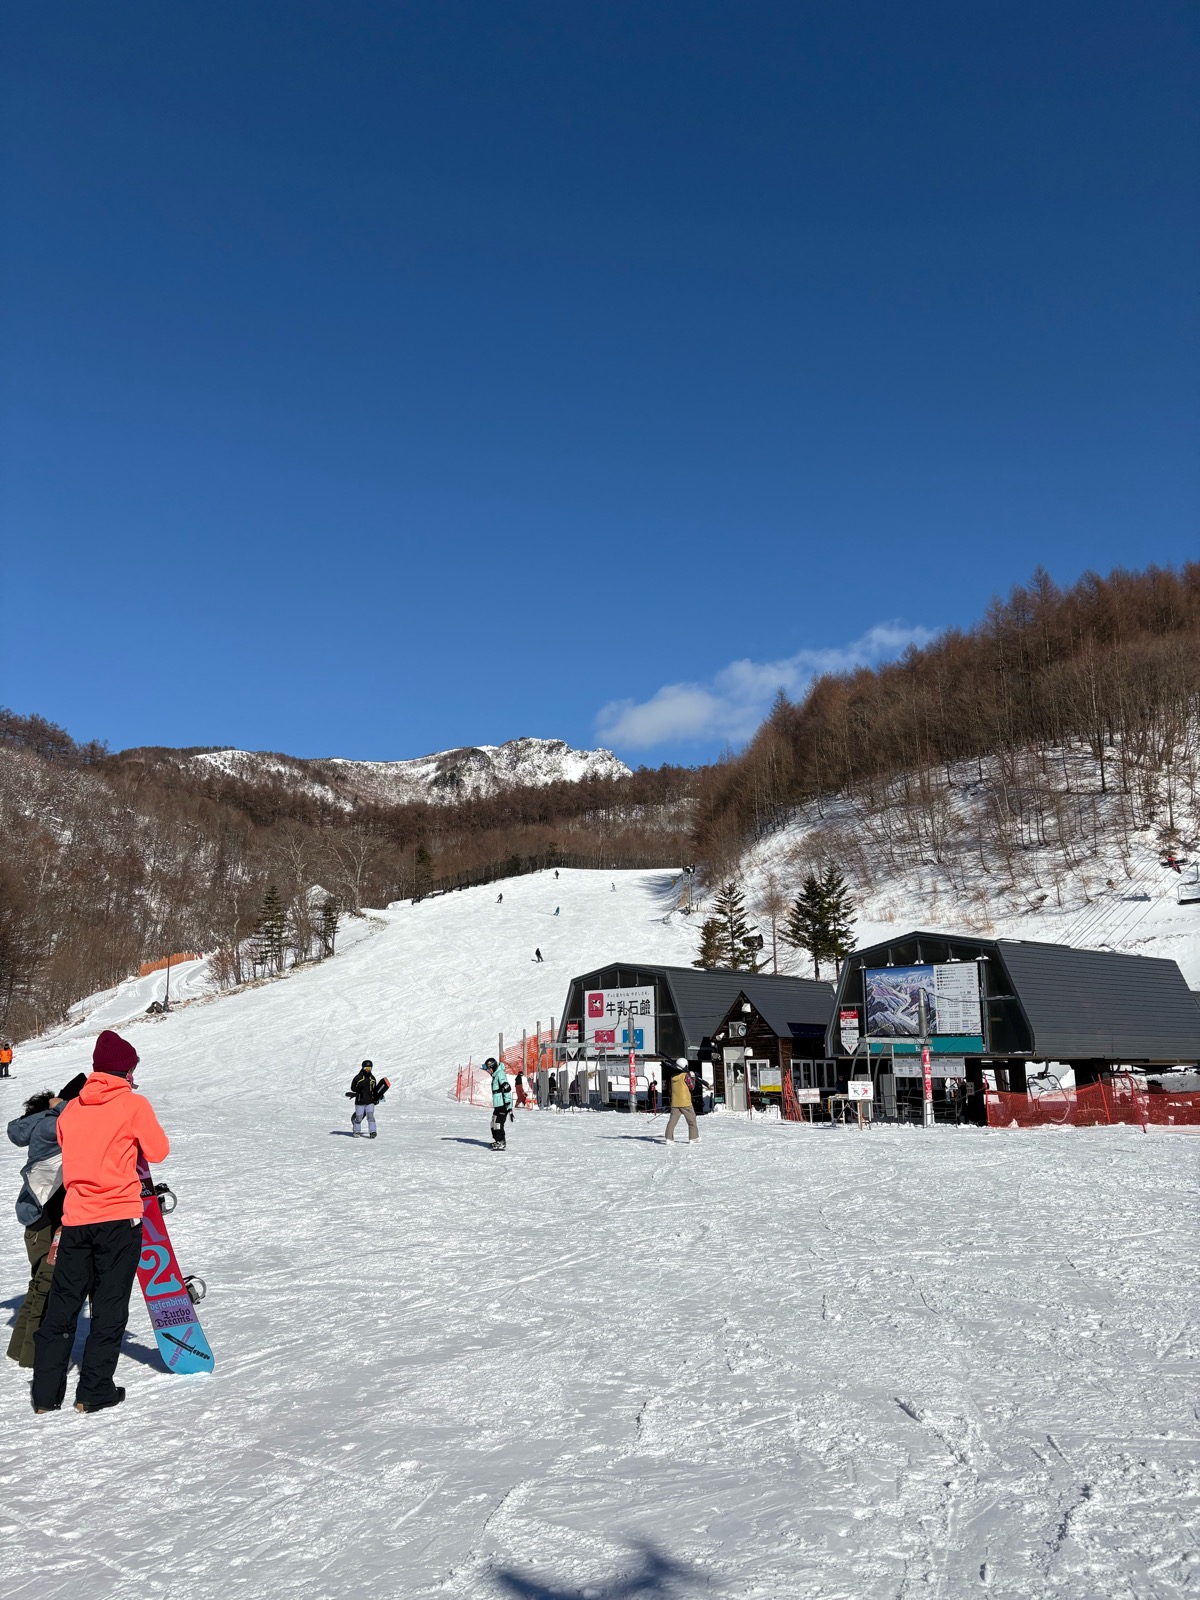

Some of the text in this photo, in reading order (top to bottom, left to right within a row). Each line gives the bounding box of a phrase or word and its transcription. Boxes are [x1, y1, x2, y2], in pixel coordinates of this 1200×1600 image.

[138, 1244, 183, 1297] 2
[148, 1297, 190, 1313] defending
[161, 1307, 191, 1320] Turbo
